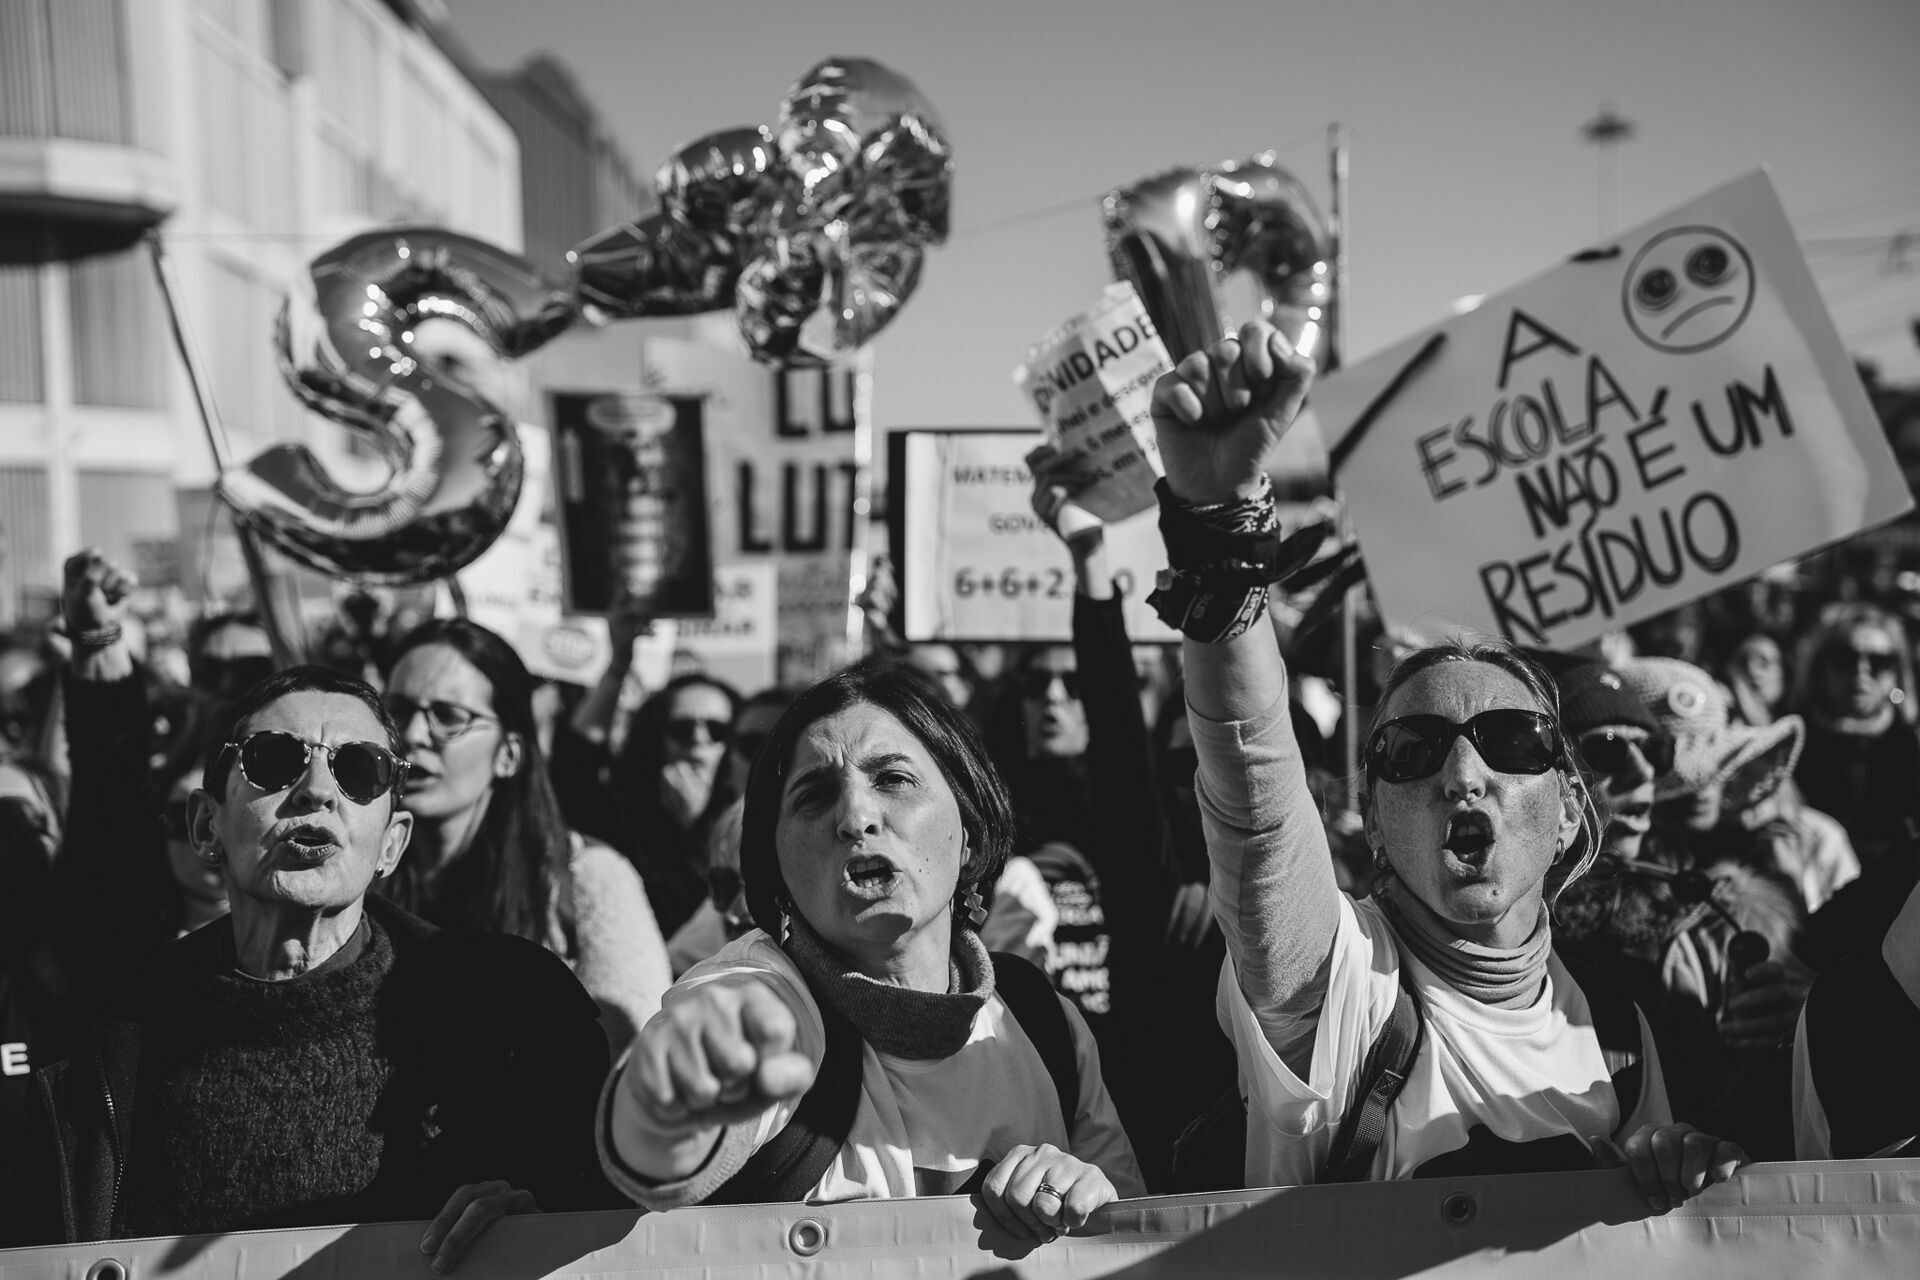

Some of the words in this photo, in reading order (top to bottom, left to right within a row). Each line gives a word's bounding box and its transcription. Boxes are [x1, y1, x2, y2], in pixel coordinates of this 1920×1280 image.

[1497, 309, 1581, 390] A
[1414, 353, 1642, 502] ESCOLA
[1515, 432, 1620, 539] NÃO
[1626, 385, 1687, 491] É
[1692, 363, 1794, 457] UM
[1477, 490, 1740, 645] RESÍDUO
